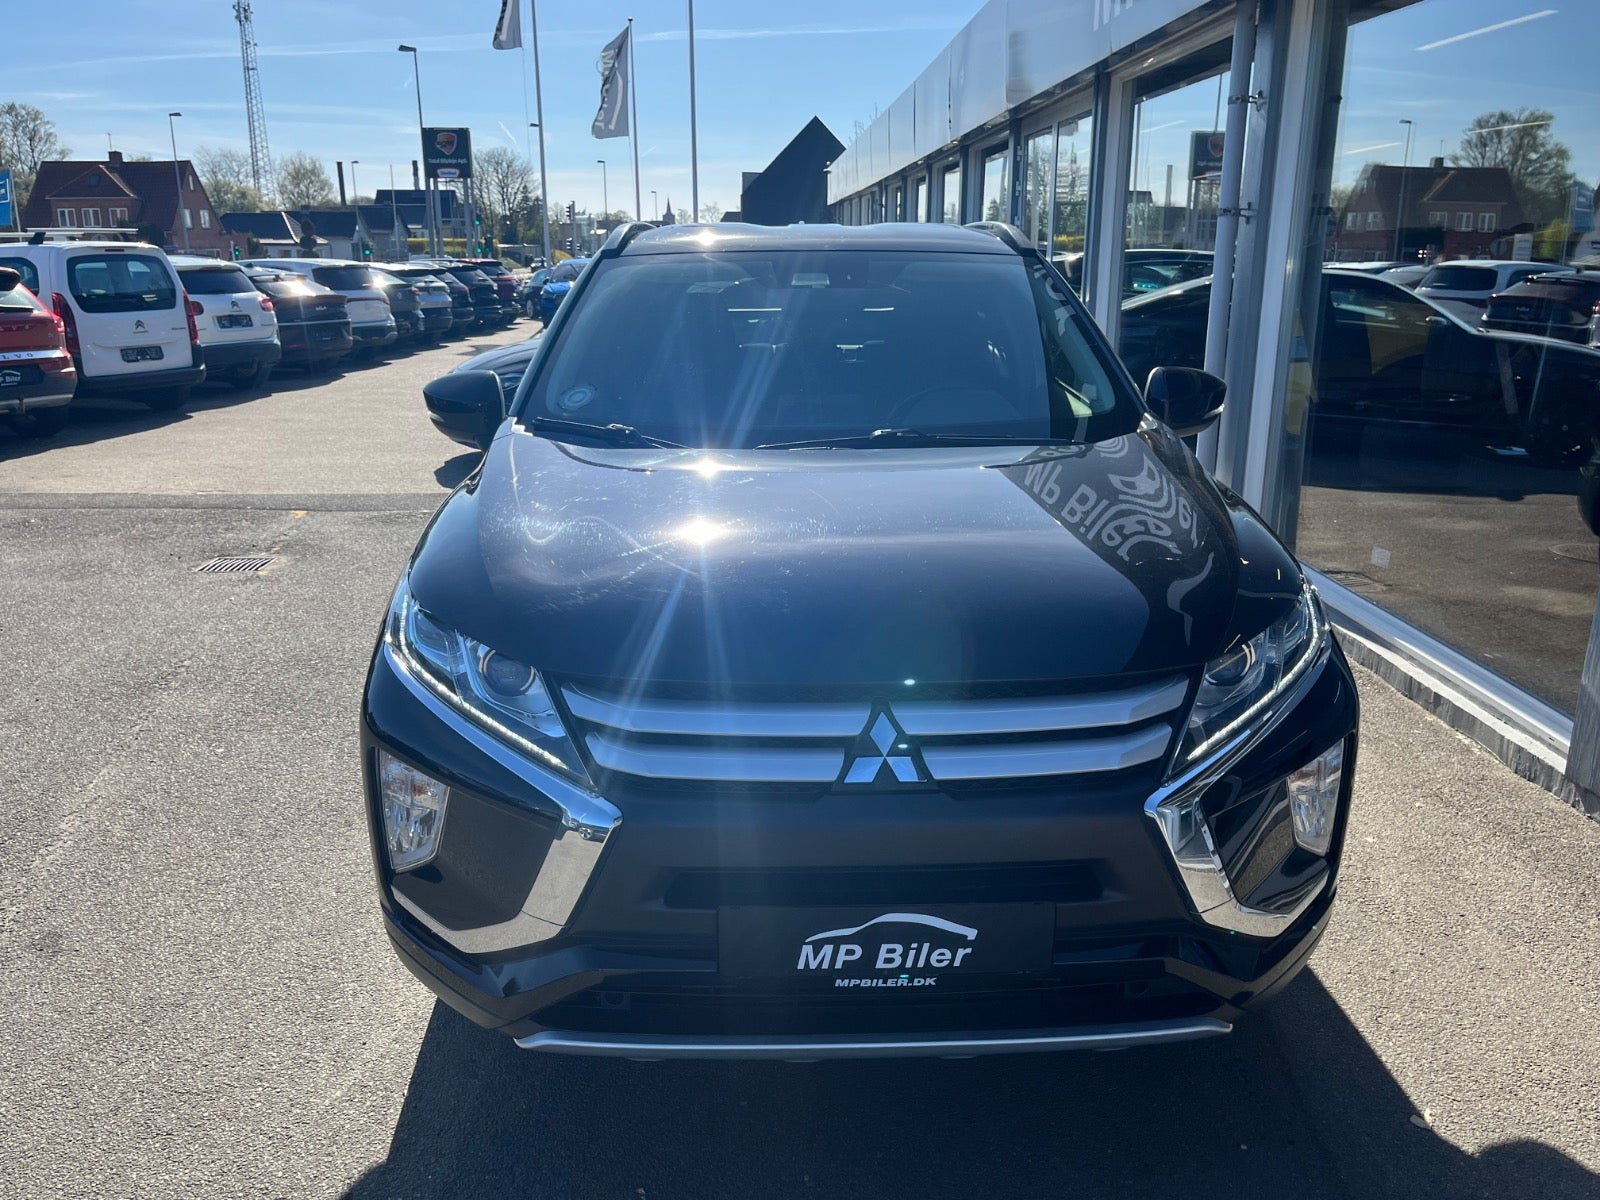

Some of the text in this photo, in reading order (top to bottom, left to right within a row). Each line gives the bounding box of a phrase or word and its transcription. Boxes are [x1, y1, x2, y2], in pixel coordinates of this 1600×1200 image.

[797, 942, 972, 970] MP Biler
[834, 977, 937, 987] MPBILER.DK
